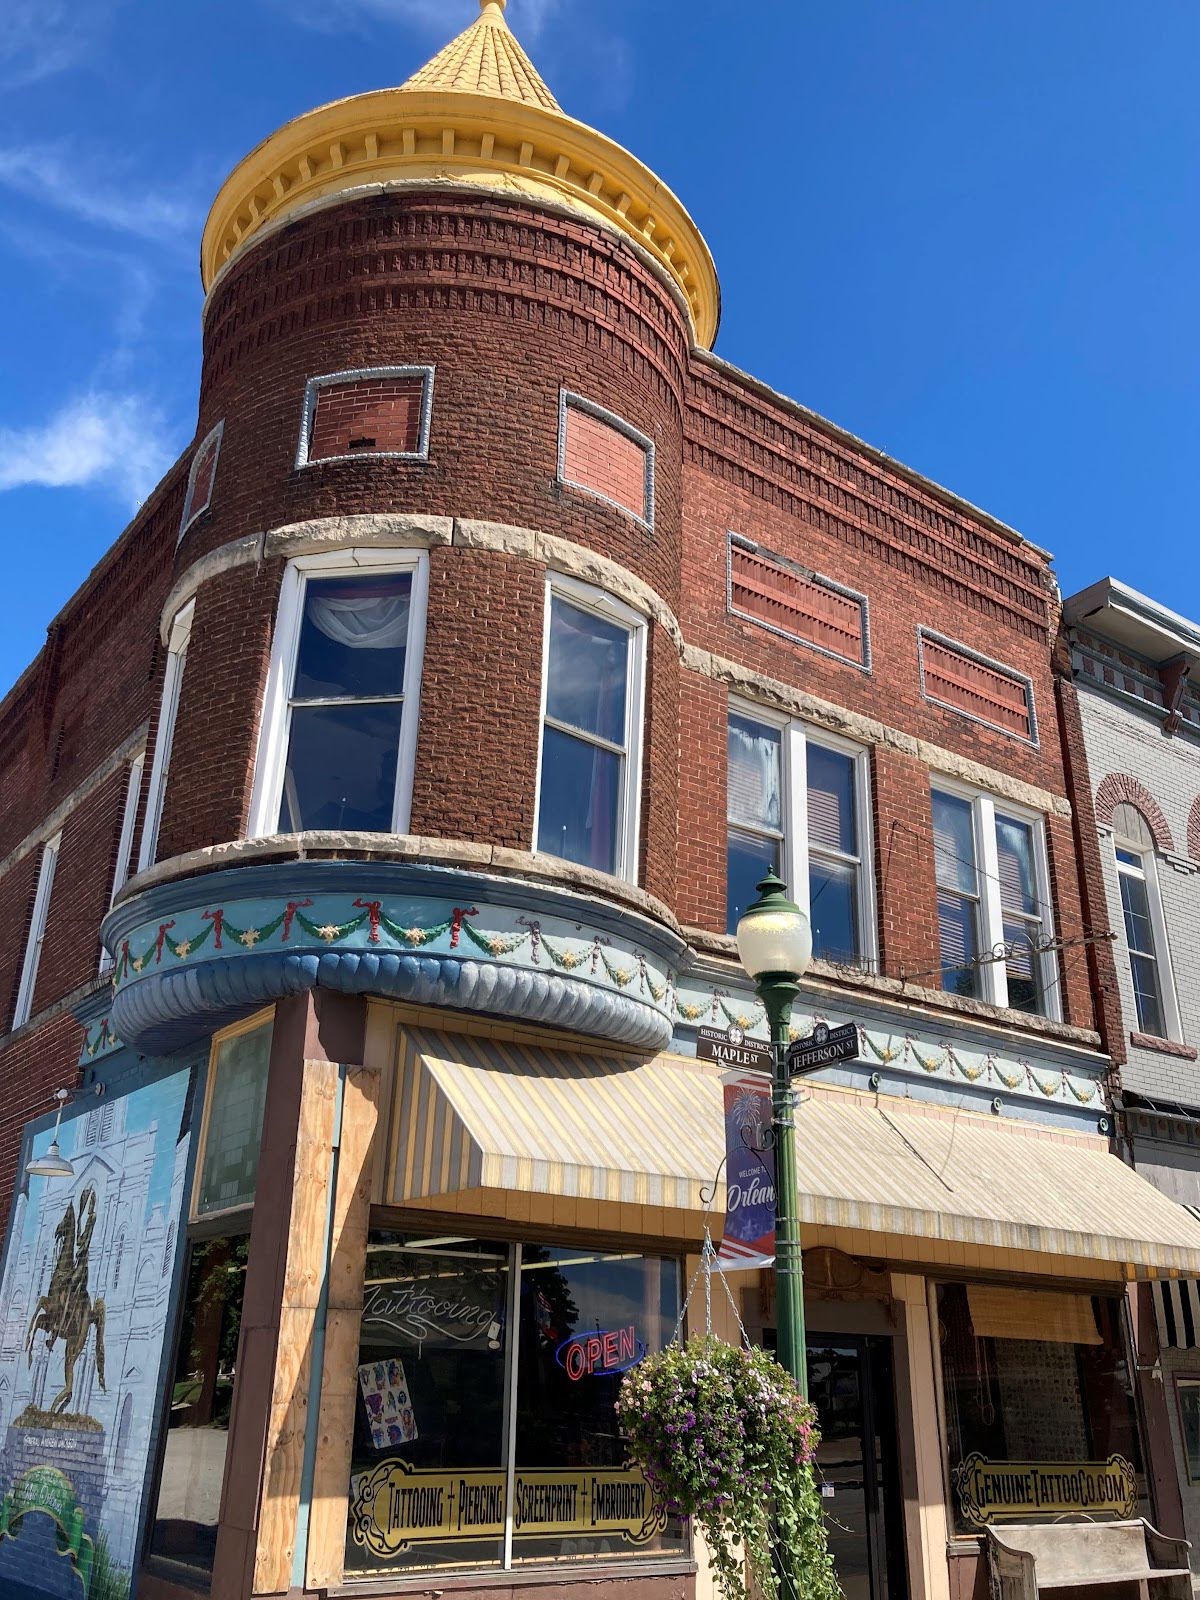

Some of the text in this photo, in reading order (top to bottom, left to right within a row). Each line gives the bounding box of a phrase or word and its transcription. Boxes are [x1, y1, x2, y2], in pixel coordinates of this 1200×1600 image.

[700, 1028, 770, 1052] HISTORIC DISTRICT
[711, 1043, 760, 1065] MAPLE ST
[791, 1027, 854, 1051] HISTORIC DISTRICT
[792, 1040, 854, 1072] JEFFERSON ST
[738, 1166, 761, 1178] WELCOME
[727, 1177, 776, 1212] Orlean
[362, 1284, 498, 1341] Tattooing
[565, 1325, 636, 1382] OPEN
[974, 1468, 1126, 1508] GENUINETATTOOCO.COM
[387, 1477, 646, 1535] TATTOOING PIERCING SCREENPRINT EMBROIDERY
